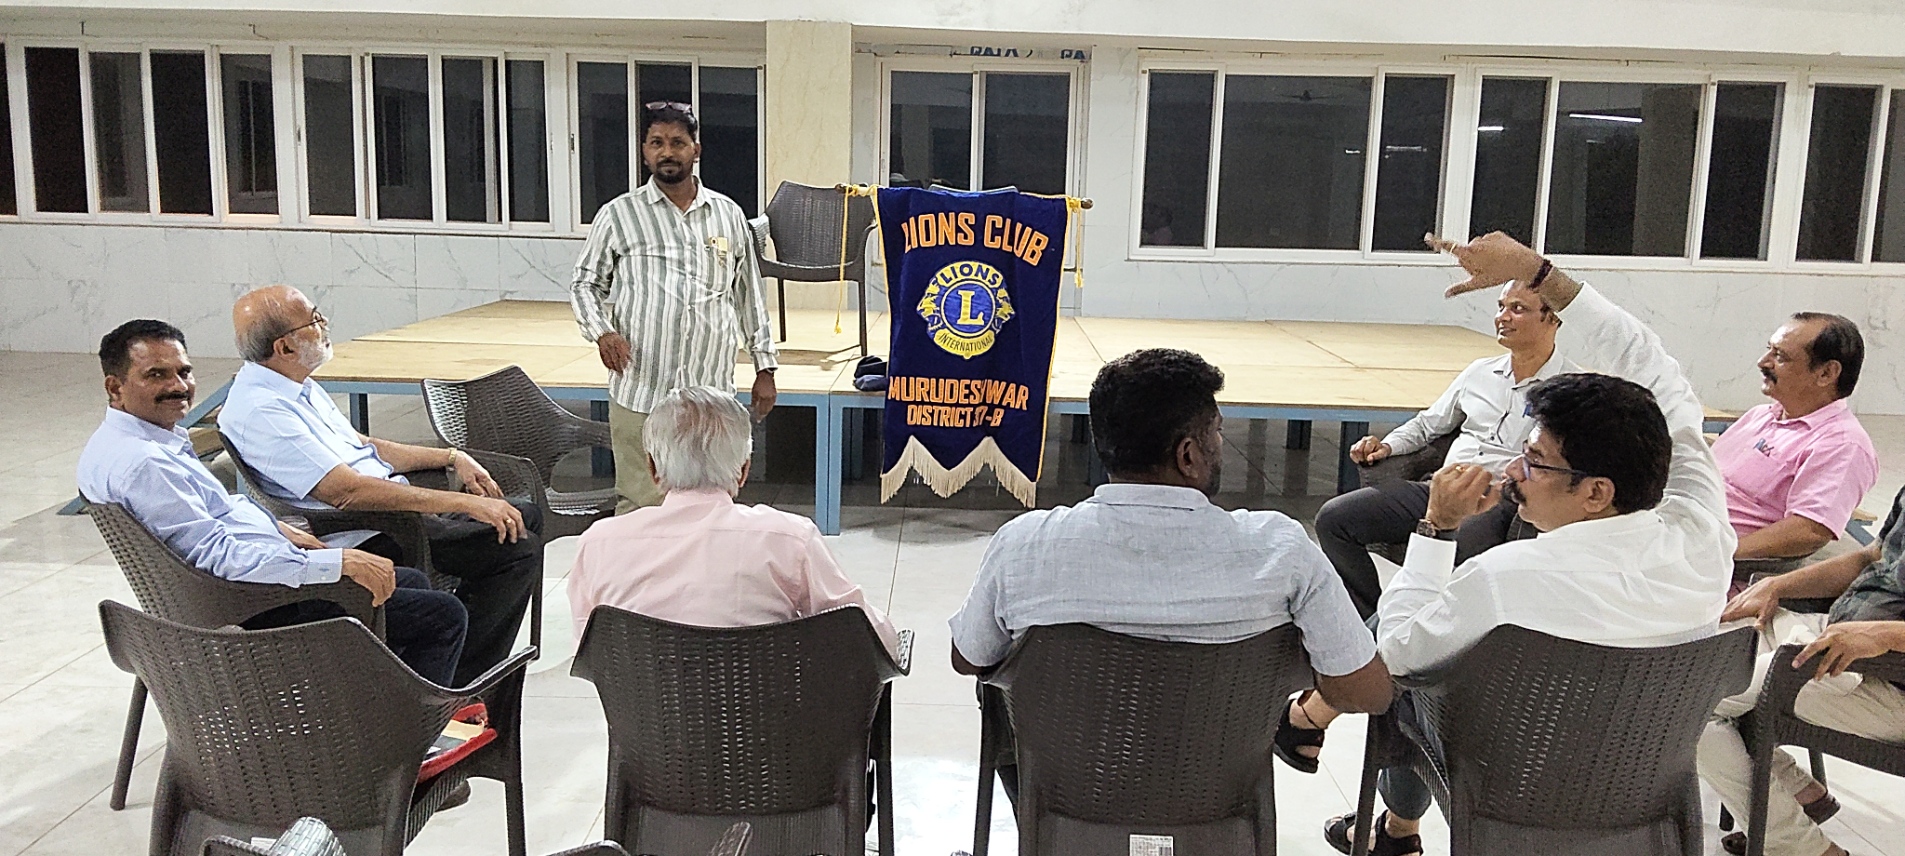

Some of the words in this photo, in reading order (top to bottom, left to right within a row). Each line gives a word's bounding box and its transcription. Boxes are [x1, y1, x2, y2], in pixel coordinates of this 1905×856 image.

[901, 212, 975, 253] LIONS
[984, 215, 1049, 266] CLUB
[940, 263, 1000, 286] LIONS
[957, 290, 985, 325] L
[939, 332, 994, 352] INTERNATIONAL
[906, 404, 974, 428] DISTRICT
